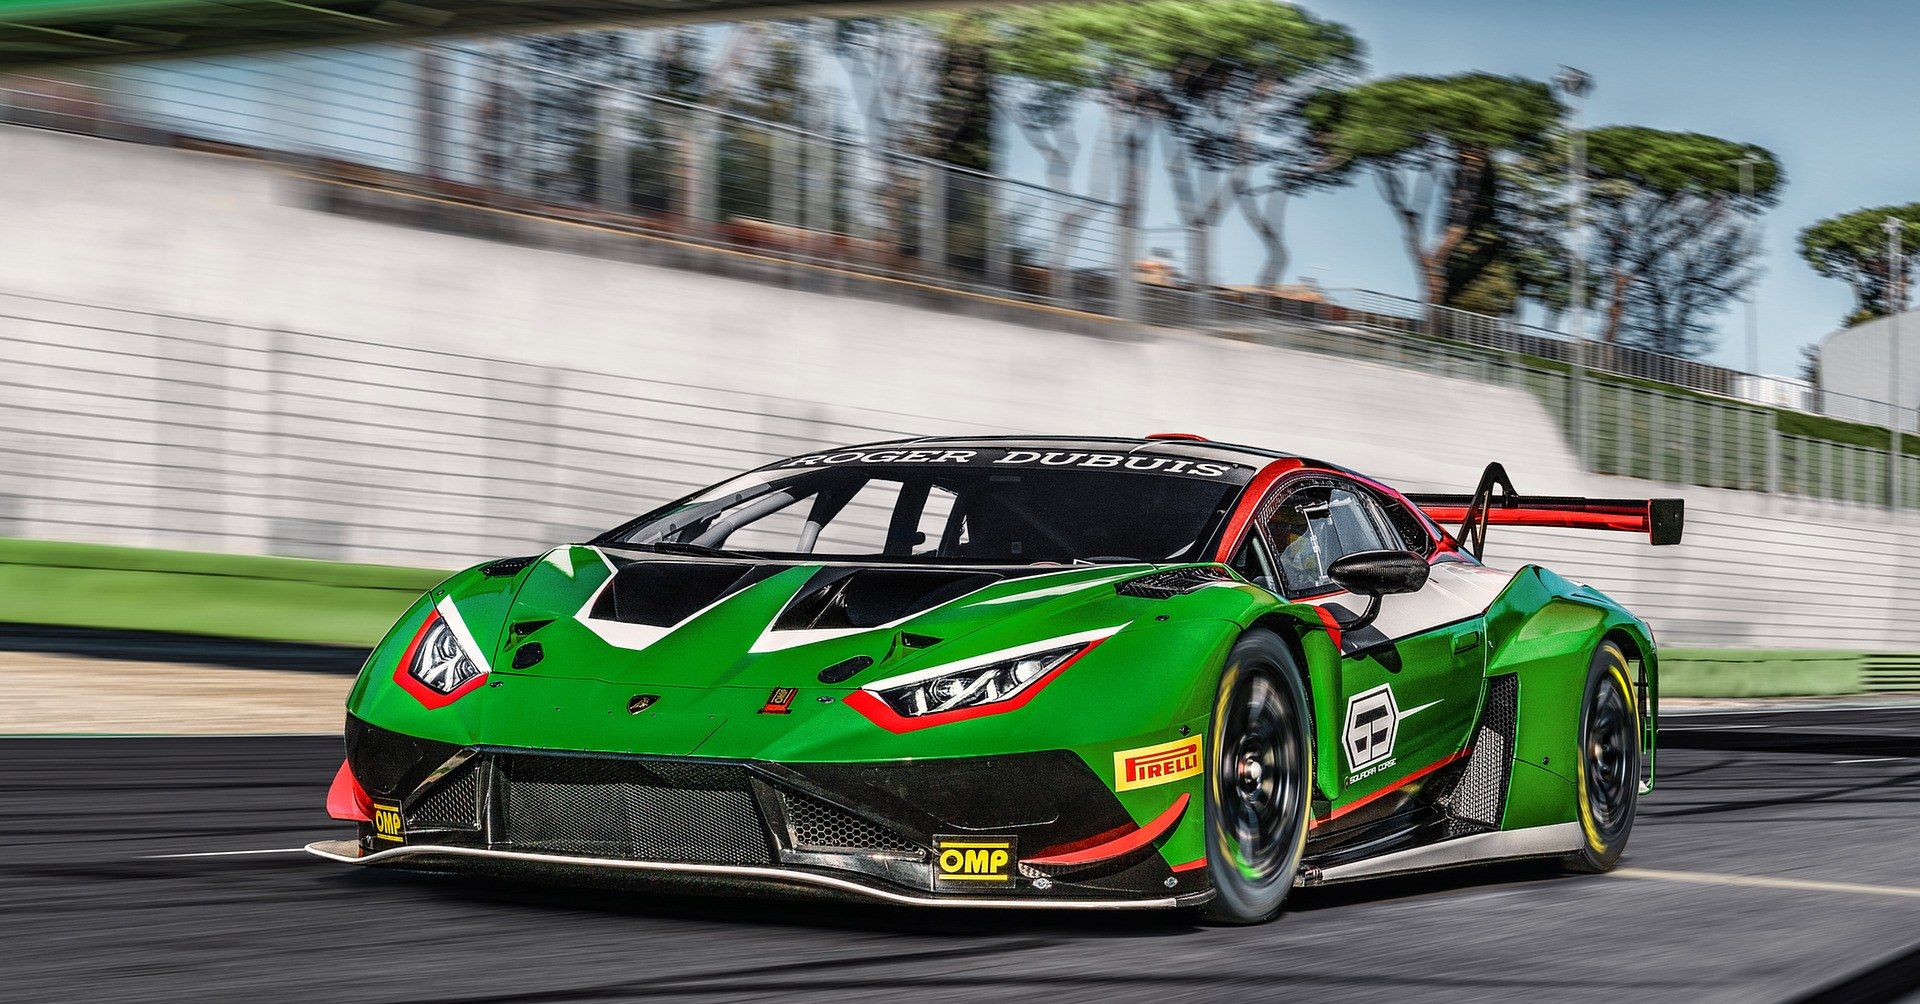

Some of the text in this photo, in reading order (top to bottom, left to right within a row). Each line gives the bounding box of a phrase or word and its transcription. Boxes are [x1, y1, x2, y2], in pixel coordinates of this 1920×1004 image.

[780, 450, 1230, 477] ROGER DUBUIS
[1125, 743, 1198, 782] PIRELLI
[375, 810, 401, 835] OMP
[939, 849, 1009, 874] OMP
